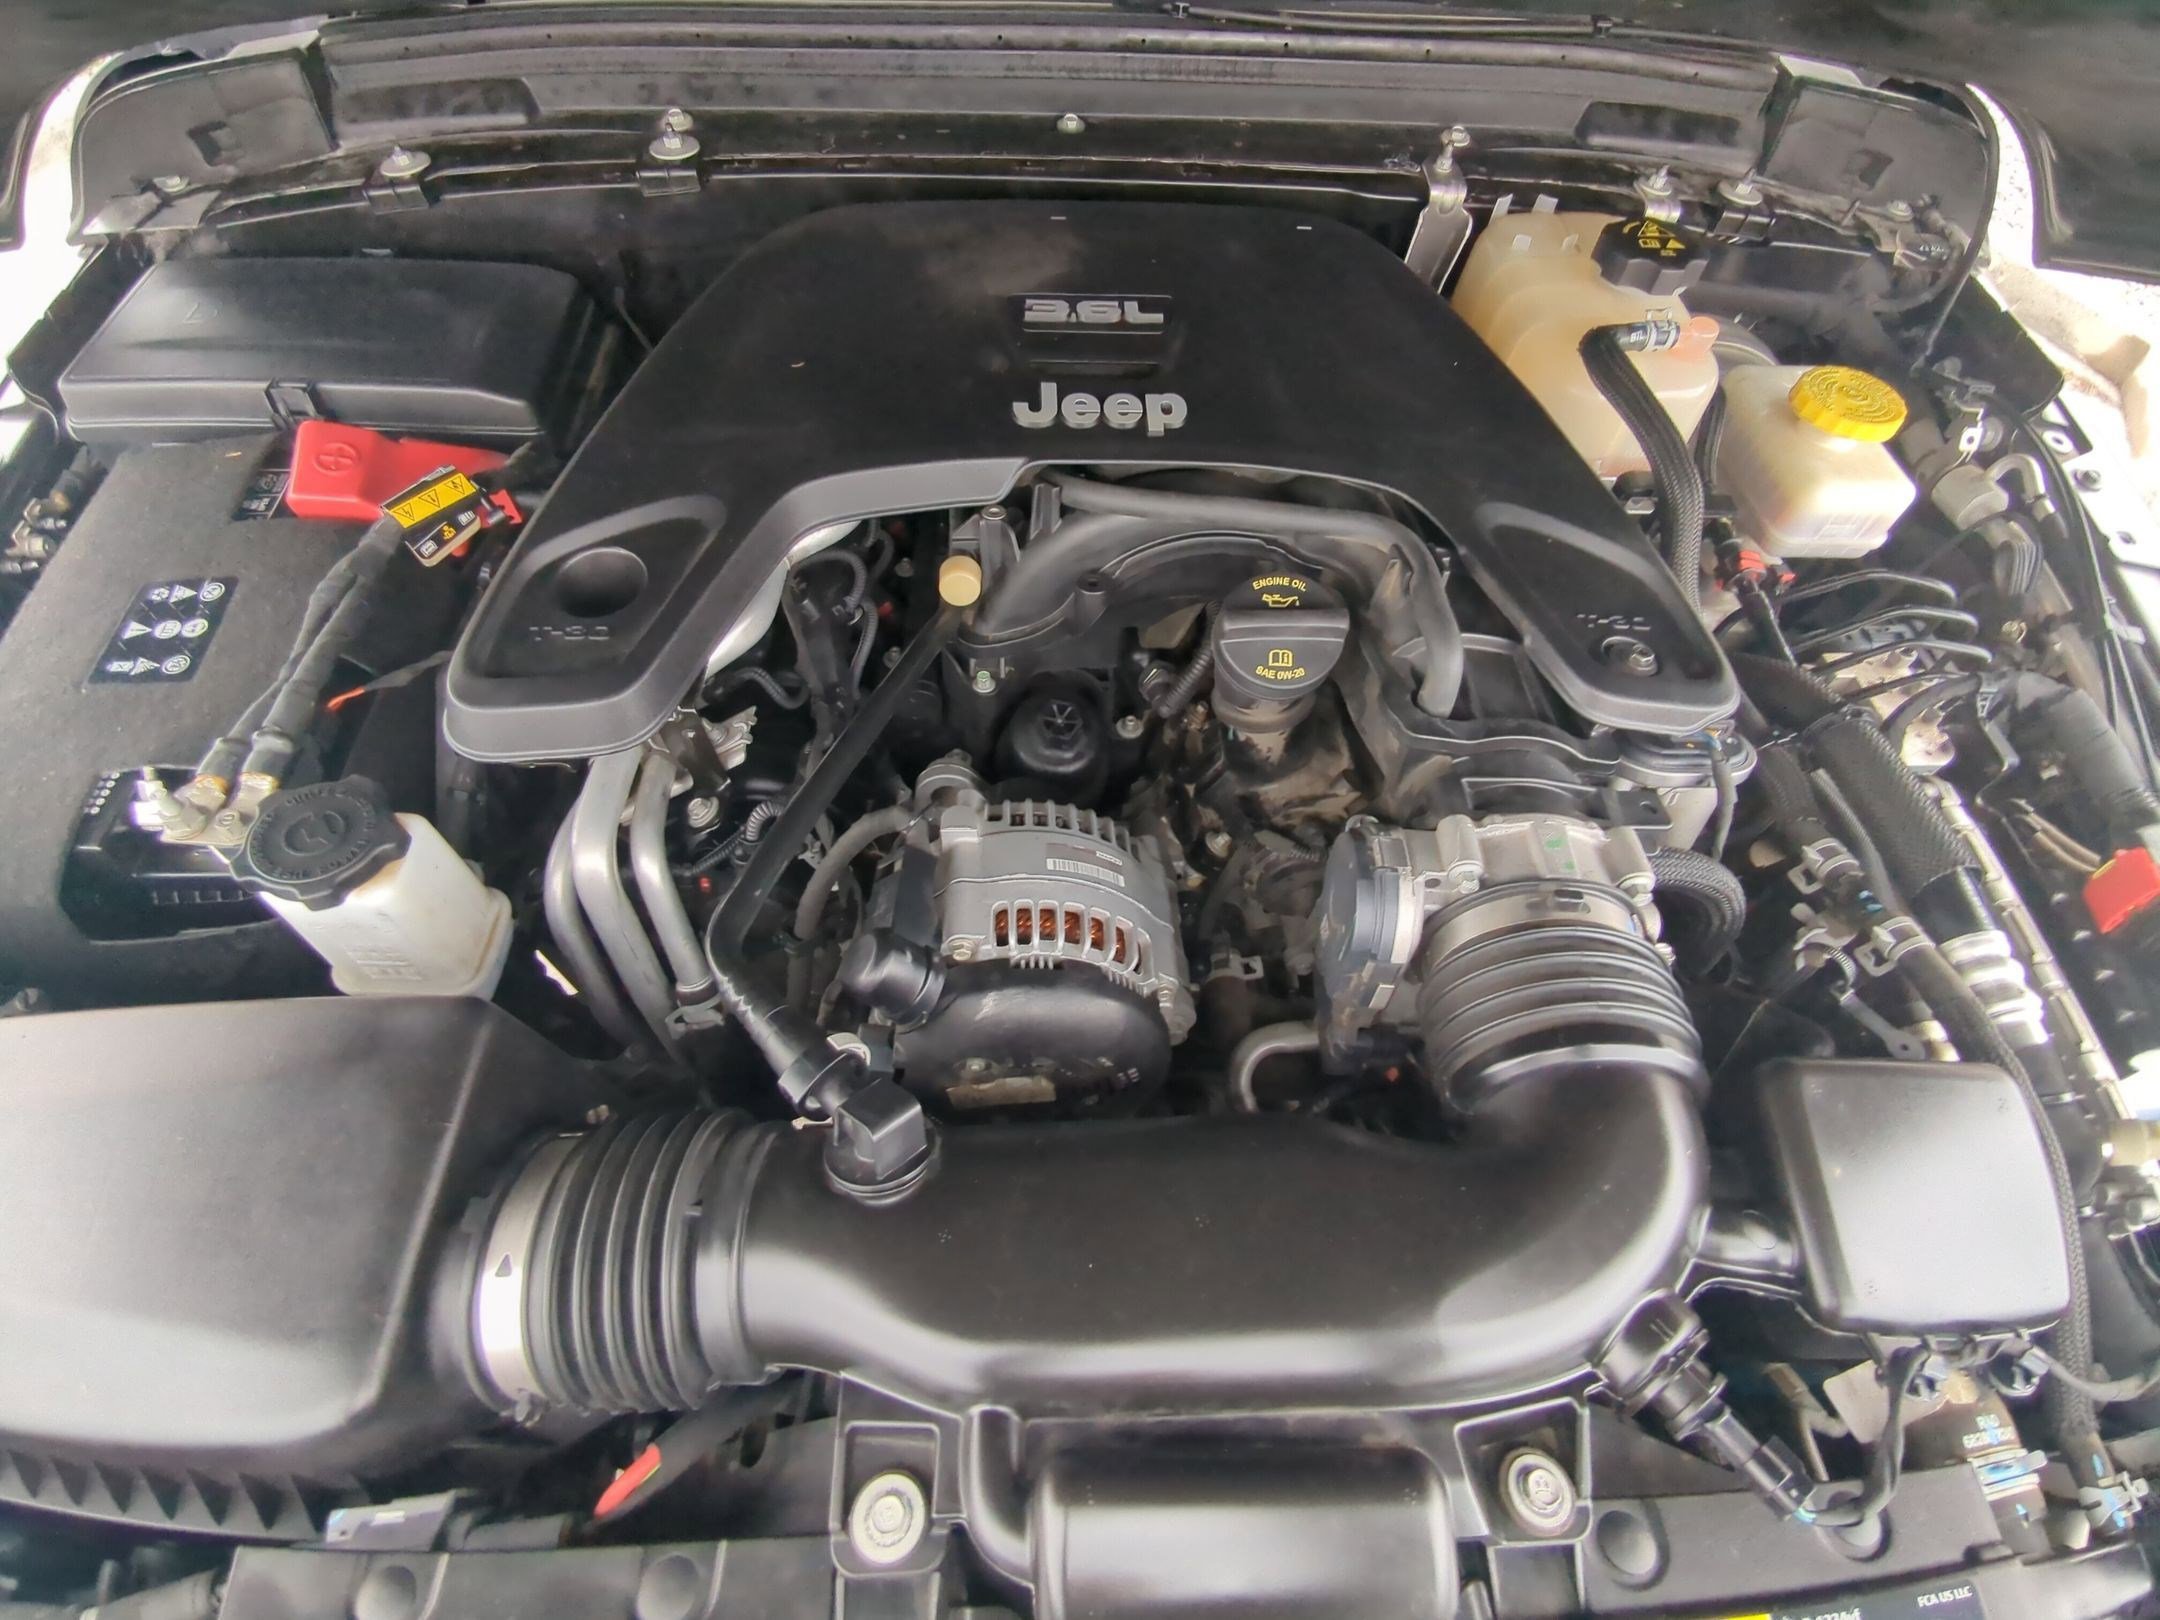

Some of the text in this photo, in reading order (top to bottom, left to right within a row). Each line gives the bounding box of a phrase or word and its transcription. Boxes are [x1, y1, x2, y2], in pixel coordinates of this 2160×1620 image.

[1024, 299, 1164, 324] 3.6L
[1012, 382, 1188, 437] Jeep
[1252, 576, 1307, 592] ENGINE OIL
[1255, 665, 1306, 680] SAE 0W-20
[1917, 1592, 1939, 1608] FCA
